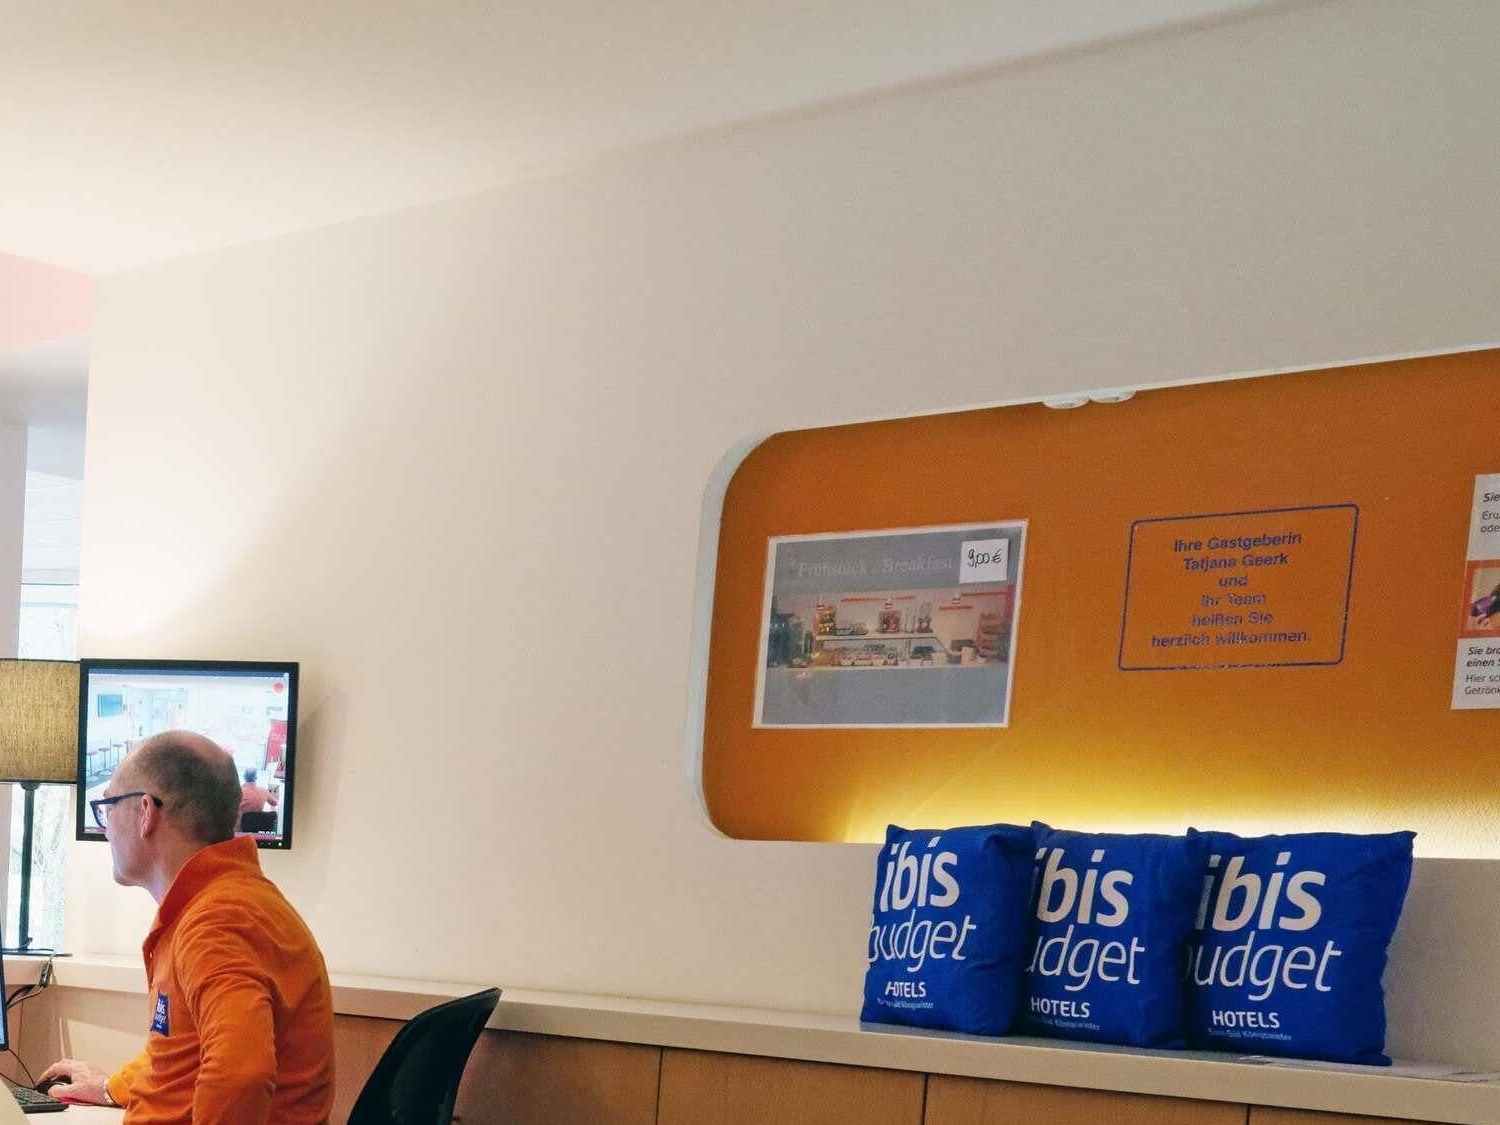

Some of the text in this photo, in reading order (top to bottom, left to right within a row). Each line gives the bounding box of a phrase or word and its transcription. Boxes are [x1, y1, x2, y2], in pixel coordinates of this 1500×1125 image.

[1174, 531, 1301, 552] Ihre Gastgeberin
[1183, 556, 1236, 572] Tatjana
[1218, 575, 1248, 587] und
[1151, 634, 1209, 648] herzlich
[1468, 647, 1483, 655] Sie
[1467, 657, 1494, 667] einen
[879, 836, 960, 912] ibis
[1195, 851, 1326, 932] ibis
[1190, 930, 1342, 1001] udget
[884, 980, 927, 998] HOTELS
[1031, 996, 1091, 1018] HOTELS
[1211, 1009, 1281, 1029] HOTELS
